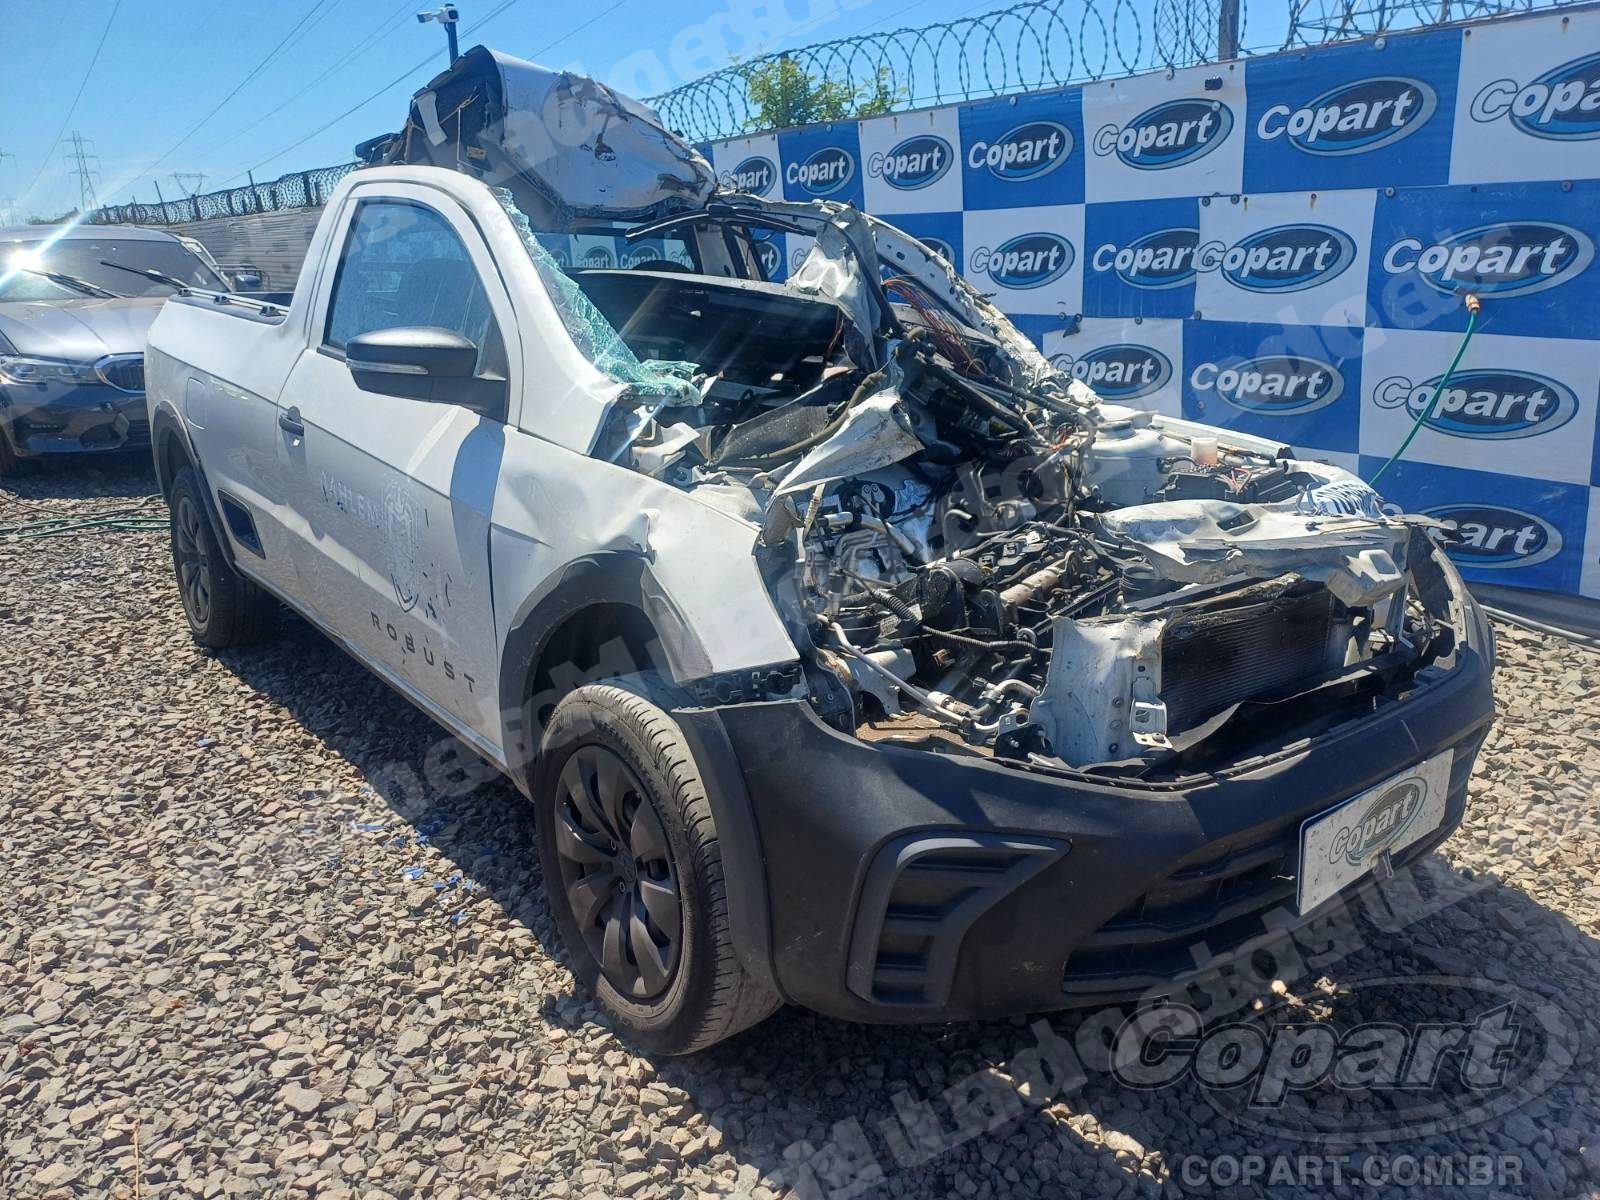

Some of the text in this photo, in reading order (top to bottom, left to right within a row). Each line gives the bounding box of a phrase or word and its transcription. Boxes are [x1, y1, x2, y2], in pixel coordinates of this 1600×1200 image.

[1092, 111, 1214, 157] Copart
[1256, 89, 1416, 142] Copart
[785, 154, 846, 187] Copart
[867, 144, 942, 180] Copart
[968, 127, 1062, 171] Copart
[720, 166, 769, 189] Cpart
[970, 242, 1061, 274] Copart
[1196, 238, 1332, 283] Copart
[1383, 236, 1567, 281] Copart
[1190, 362, 1326, 401] Copart
[1373, 376, 1548, 422] Copart
[370, 610, 476, 693] ROBUST
[1329, 789, 1416, 865] Copart
